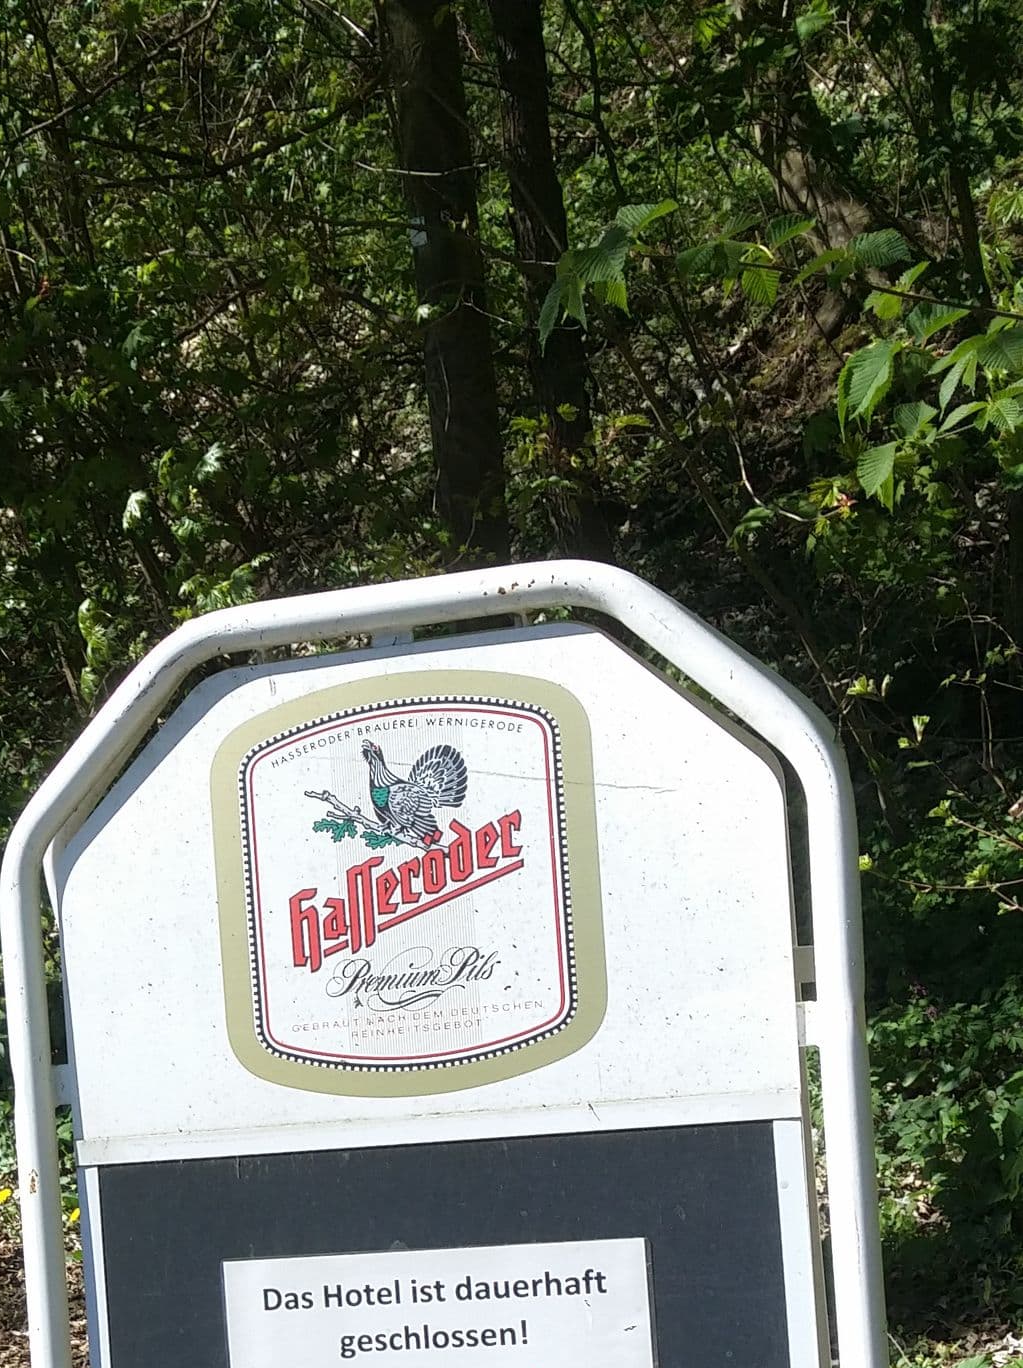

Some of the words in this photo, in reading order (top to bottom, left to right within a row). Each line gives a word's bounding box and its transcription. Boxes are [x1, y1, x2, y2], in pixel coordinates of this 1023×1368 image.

[357, 719, 418, 736] BRAUEREI
[426, 718, 523, 733] WERNIGERODE
[326, 947, 442, 1001] Premium
[439, 946, 502, 986] Pils
[292, 1018, 359, 1033] GEBRAUT
[413, 1010, 443, 1021] DEM
[451, 1000, 543, 1017] DEUTSCHEN
[352, 1019, 482, 1038] REINHEITSGEBOT
[262, 1287, 314, 1311] Das
[323, 1280, 401, 1308] Hotel
[411, 1278, 446, 1304] ist
[455, 1268, 608, 1301] dauerhaft
[340, 1319, 529, 1359] geschlossen!
